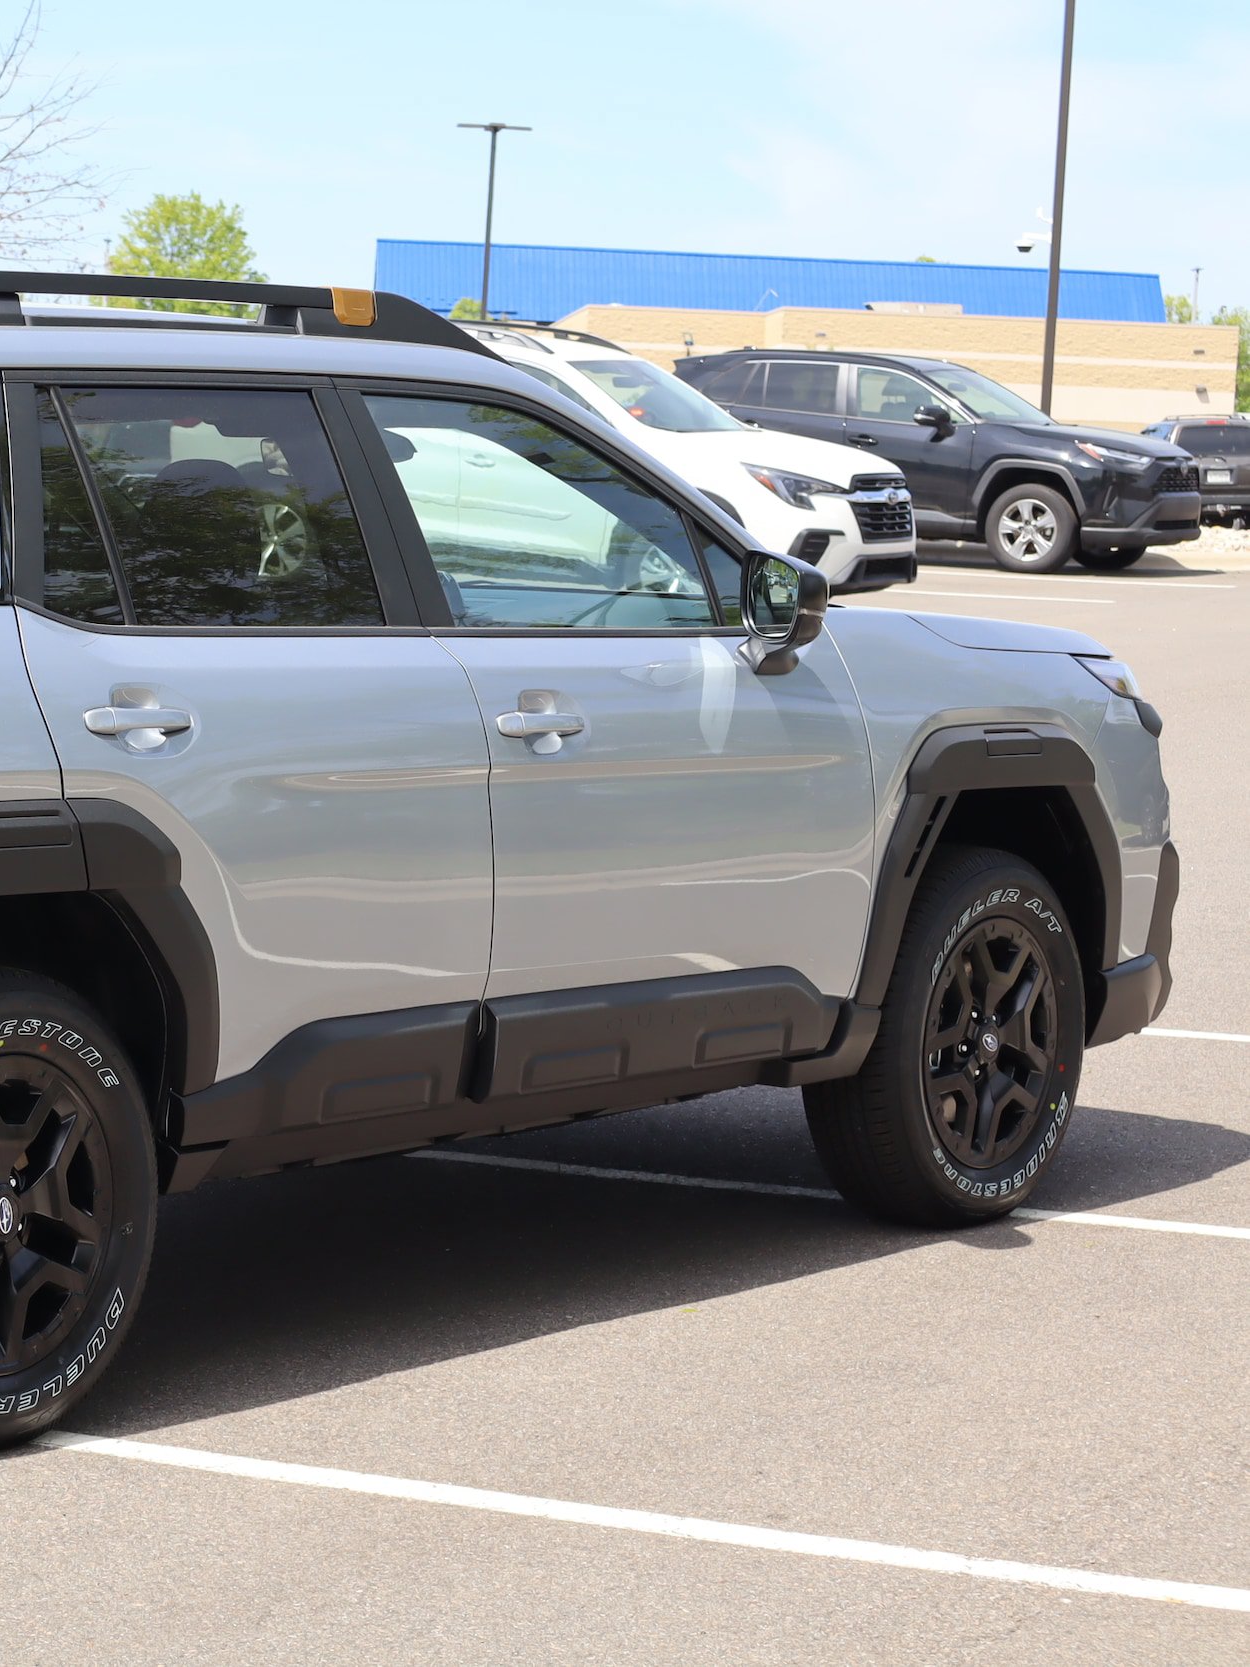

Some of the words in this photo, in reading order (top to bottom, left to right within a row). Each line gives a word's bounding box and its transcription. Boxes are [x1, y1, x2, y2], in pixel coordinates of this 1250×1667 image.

[931, 888, 1021, 985] DUELER
[1024, 898, 1062, 934] A/T
[933, 1091, 1068, 1197] BRIDGESTONE
